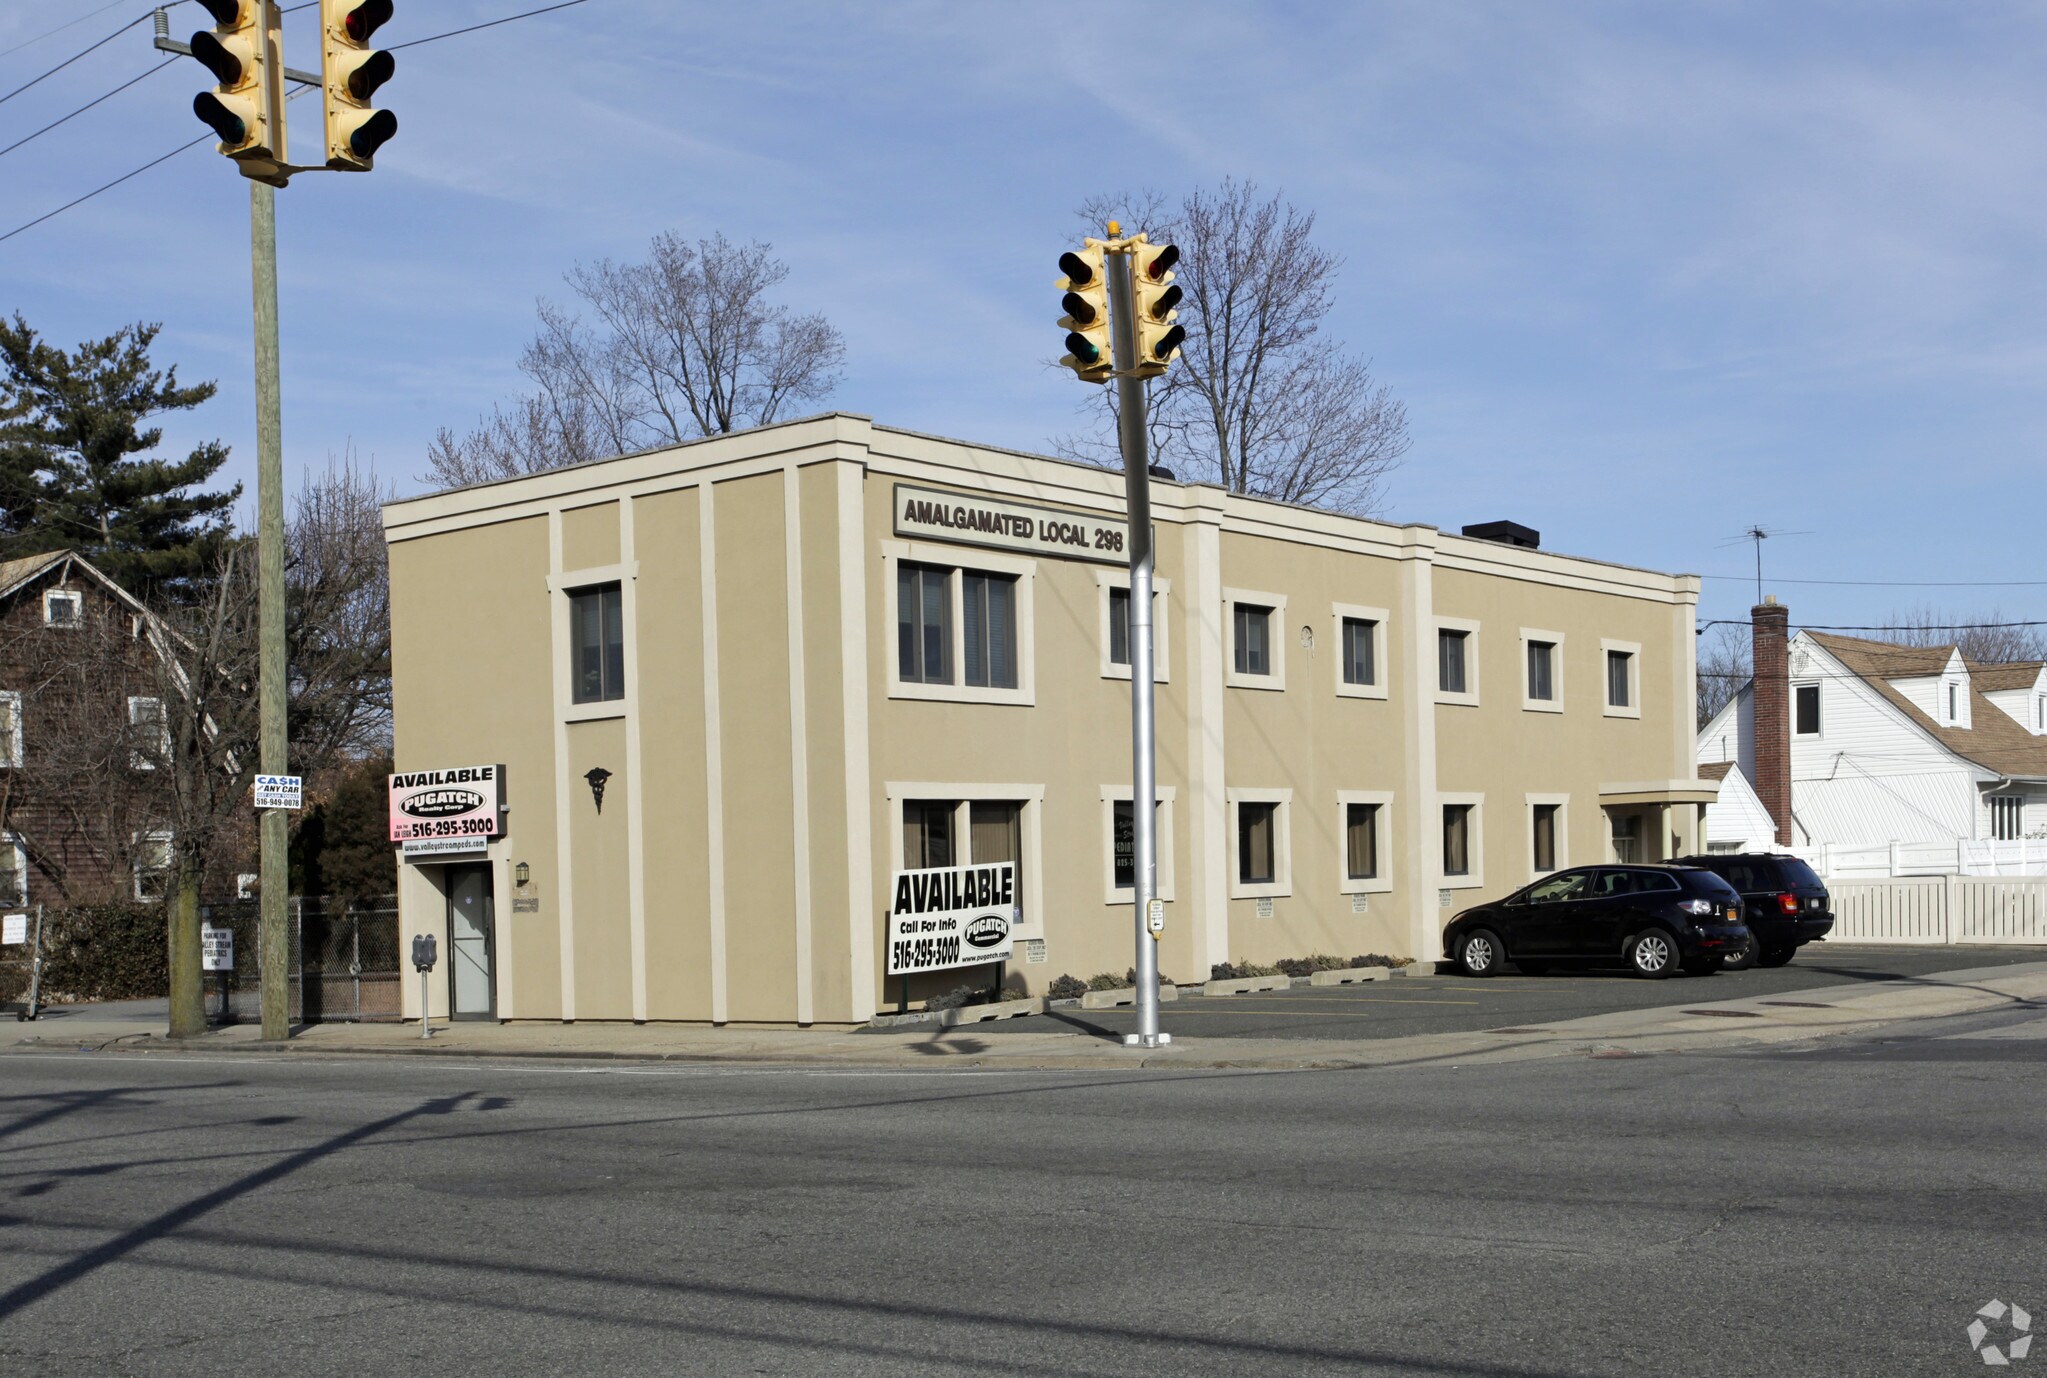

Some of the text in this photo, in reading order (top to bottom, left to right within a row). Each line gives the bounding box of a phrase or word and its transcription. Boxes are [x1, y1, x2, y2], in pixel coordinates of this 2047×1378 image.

[904, 499, 1124, 552] AMALGAMATED LOCAL 298
[392, 767, 493, 789] AVAILABLE
[256, 797, 299, 807] 516-949-0078
[404, 791, 480, 811] PUGATCH
[404, 840, 485, 852] www.valleystreampeds.com
[894, 867, 1013, 915] AVAILABLE
[900, 917, 957, 934] Call For Info
[966, 918, 1007, 940] PUGATCH
[962, 951, 1010, 963] www.pugatch.com
